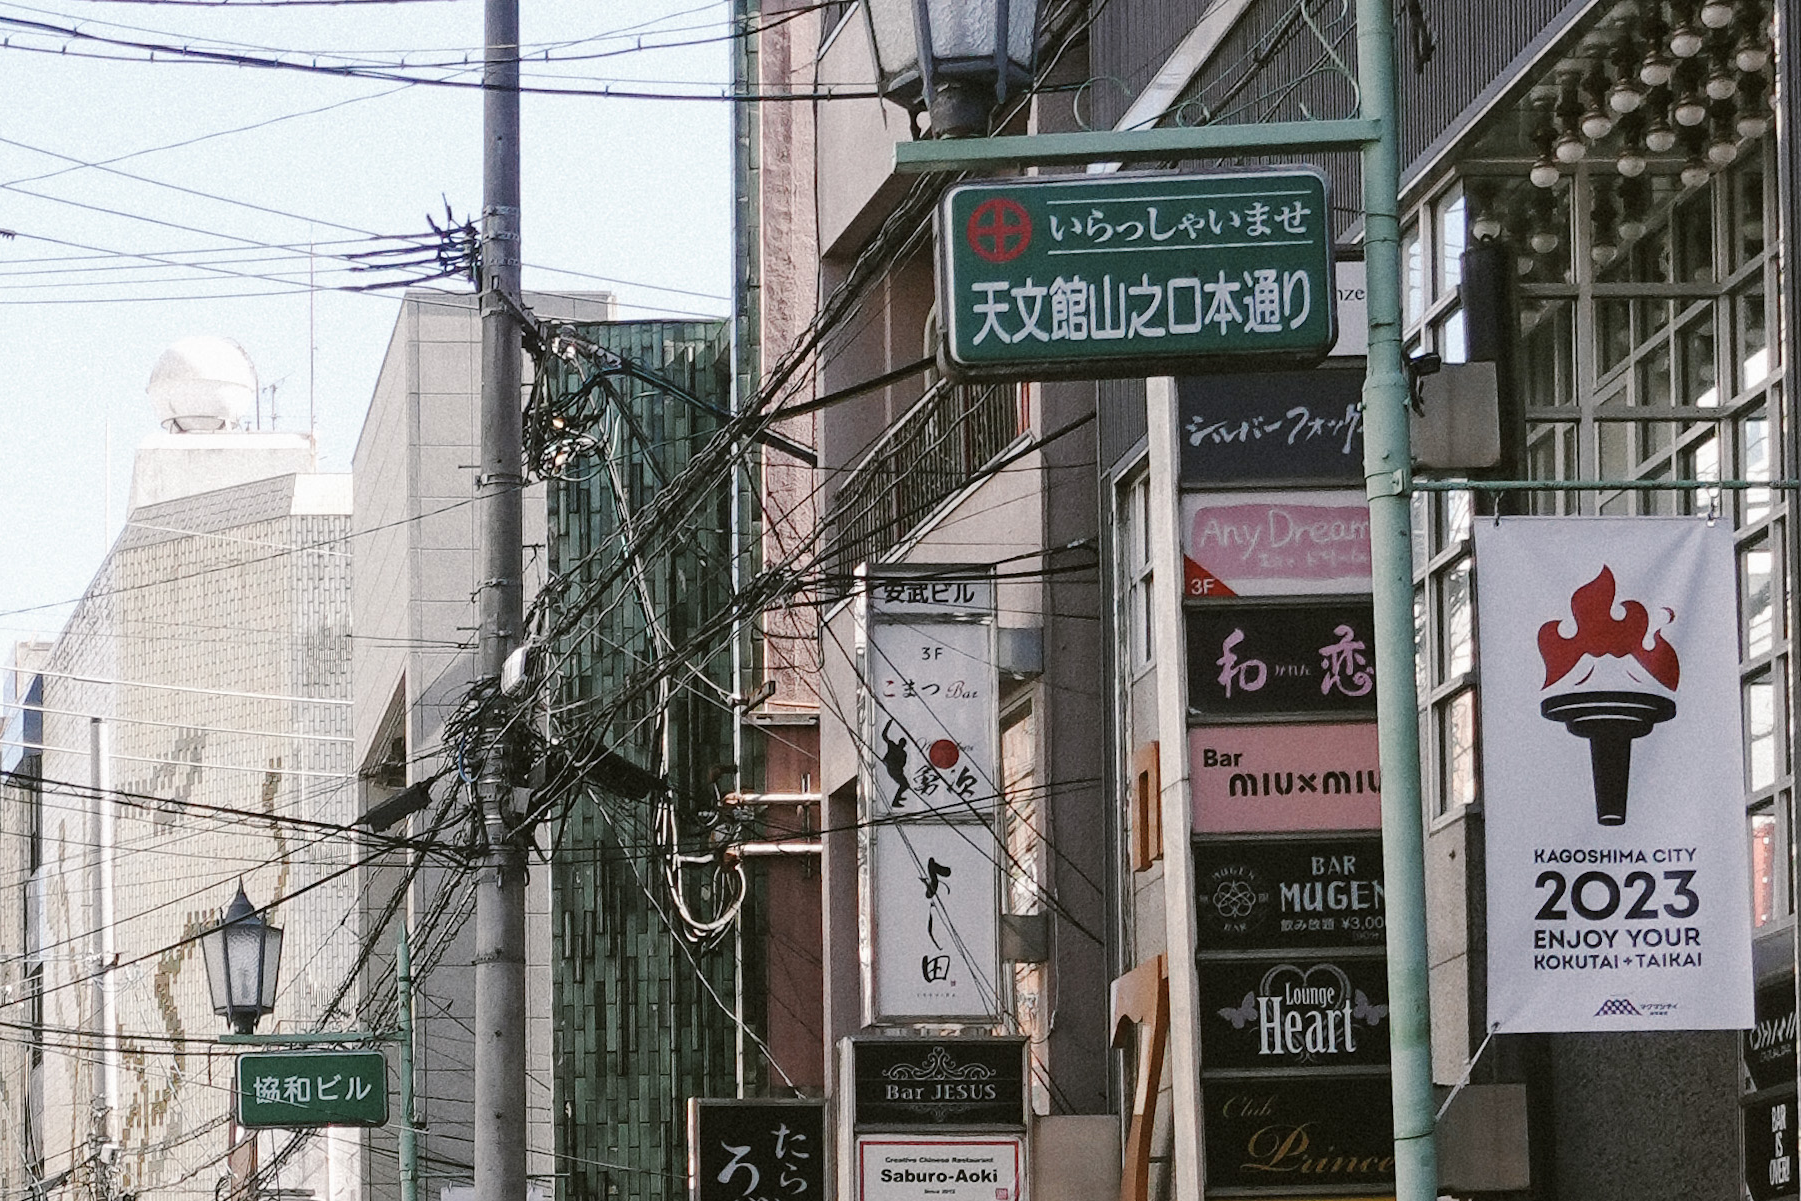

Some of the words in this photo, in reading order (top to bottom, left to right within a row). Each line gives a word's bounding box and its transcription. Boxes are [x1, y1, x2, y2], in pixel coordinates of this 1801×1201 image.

[1049, 201, 1312, 243] いらっしゃいませ
[972, 268, 1311, 346] 天文館山之口本通り
[1201, 520, 1261, 560] Any
[884, 583, 975, 604] 安武ビル
[1191, 578, 1215, 595] 3F
[921, 648, 943, 661] 3F
[1216, 628, 1268, 699] 和
[1318, 624, 1375, 697] 恋
[884, 678, 940, 698] こまつ
[946, 680, 978, 699] Bar
[1203, 748, 1243, 768] Bar
[1310, 855, 1356, 876] BAR
[1534, 849, 1648, 864] KAGOSHIMA
[1652, 847, 1697, 863] CITY
[1534, 870, 1700, 921] 2023
[1534, 928, 1619, 950] ENJOY
[1625, 927, 1701, 949] YOUR
[1534, 954, 1619, 970] KOKUTAI
[1635, 952, 1702, 968] TAIKAI
[1285, 982, 1335, 1006] Lounge
[1257, 994, 1356, 1056] Heart
[252, 1076, 373, 1105] 協和ビル
[885, 1083, 925, 1101] Bar
[931, 1082, 997, 1101] JESUS
[1771, 1104, 1787, 1133] BAR
[1774, 1131, 1784, 1158] IS
[885, 1156, 918, 1164] Creative
[919, 1156, 950, 1164] Chinese
[952, 1156, 994, 1164] Restaurant
[880, 1168, 998, 1184] Saburo-Aoki
